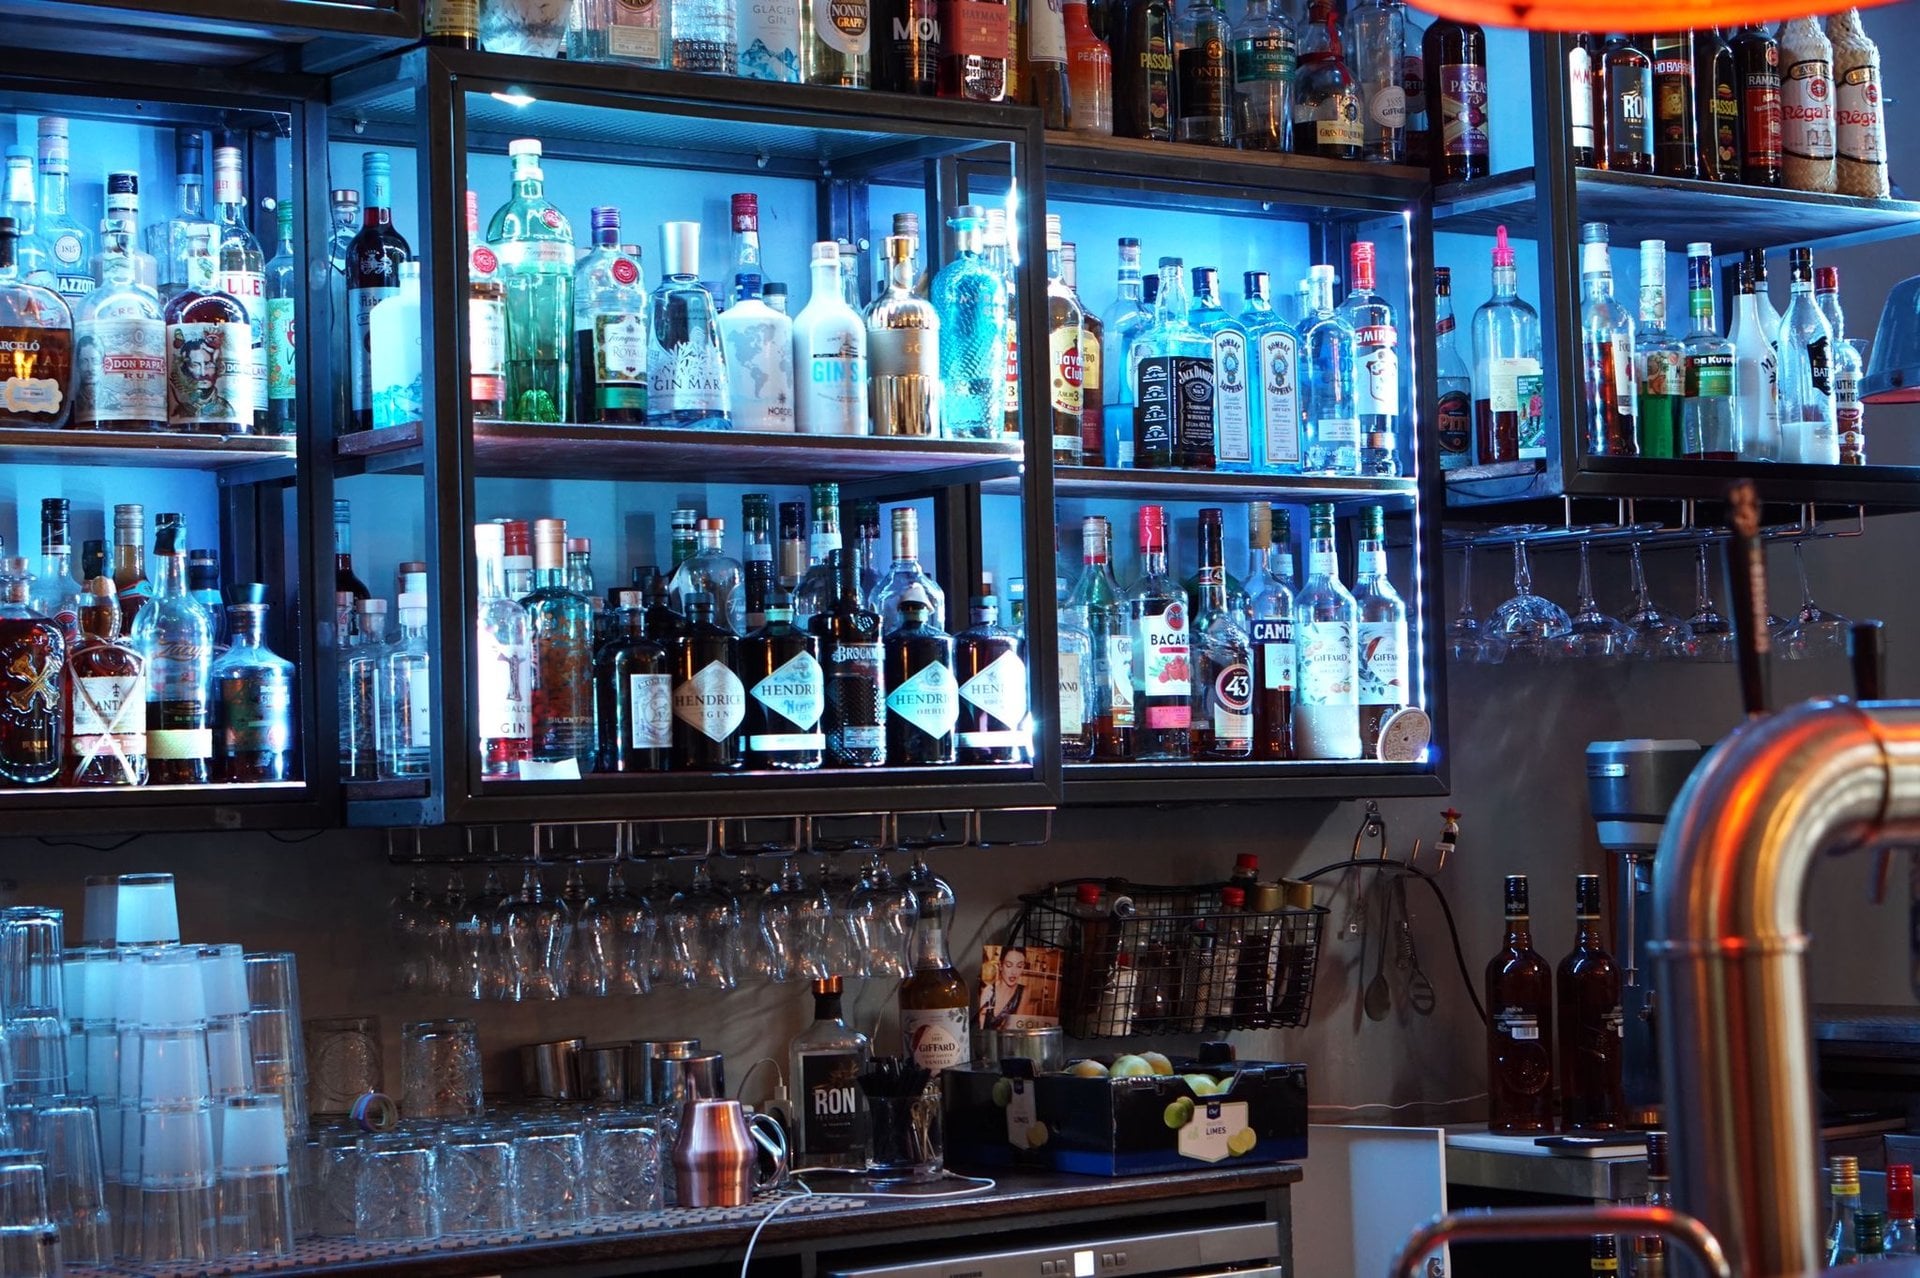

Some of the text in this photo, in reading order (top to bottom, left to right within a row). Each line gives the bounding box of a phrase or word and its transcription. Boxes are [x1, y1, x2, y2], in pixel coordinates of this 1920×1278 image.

[767, 15, 788, 25] GIN
[113, 358, 137, 369] DON
[812, 361, 846, 382] GIN
[654, 379, 683, 391] GIN
[1225, 676, 1248, 696] 43
[501, 722, 526, 734] GIN
[919, 1043, 956, 1052] GIFFARD
[814, 1086, 856, 1115] RON
[1206, 1127, 1227, 1135] LIMES
